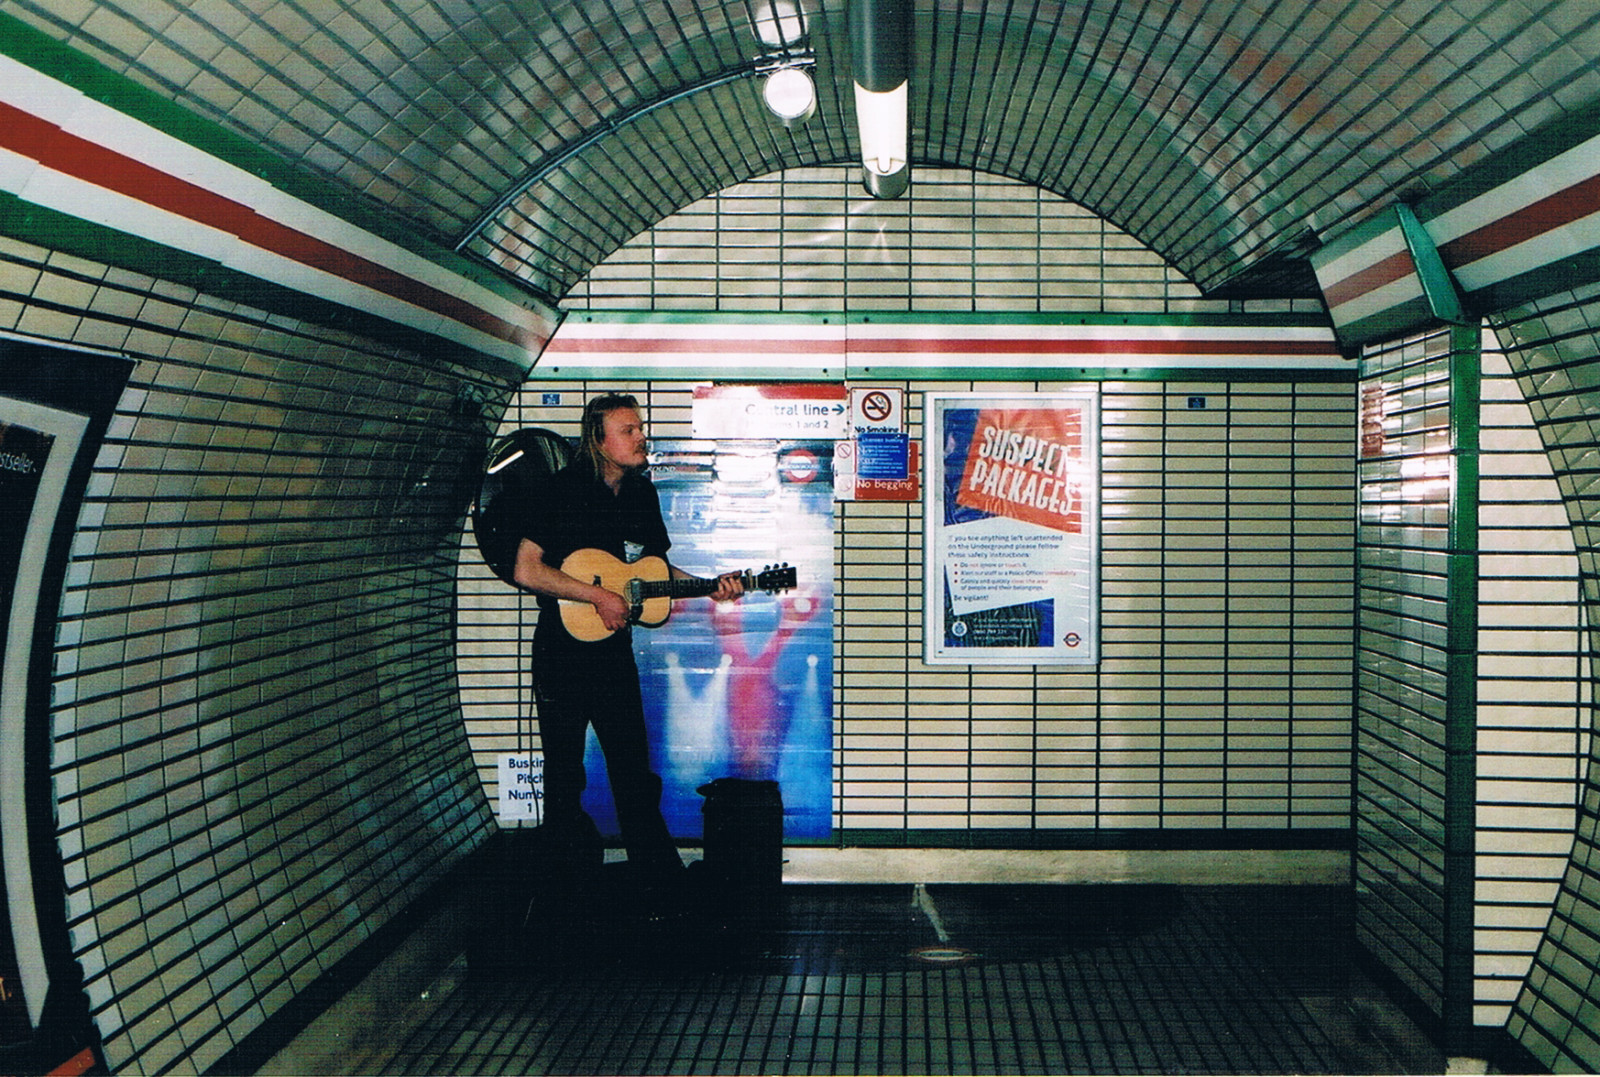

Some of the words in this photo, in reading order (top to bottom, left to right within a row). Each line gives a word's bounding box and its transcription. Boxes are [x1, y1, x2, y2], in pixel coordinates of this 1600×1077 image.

[745, 403, 798, 415] Ctral
[803, 404, 829, 415] line
[804, 420, 821, 429] and
[823, 420, 829, 429] 2
[979, 426, 1071, 478] SUSPECT
[857, 480, 871, 488] No
[875, 480, 913, 491] begging
[970, 459, 1073, 515] PACKAGES
[508, 758, 545, 769] Buskin
[508, 789, 545, 800] Numb
[527, 802, 532, 813] 1
